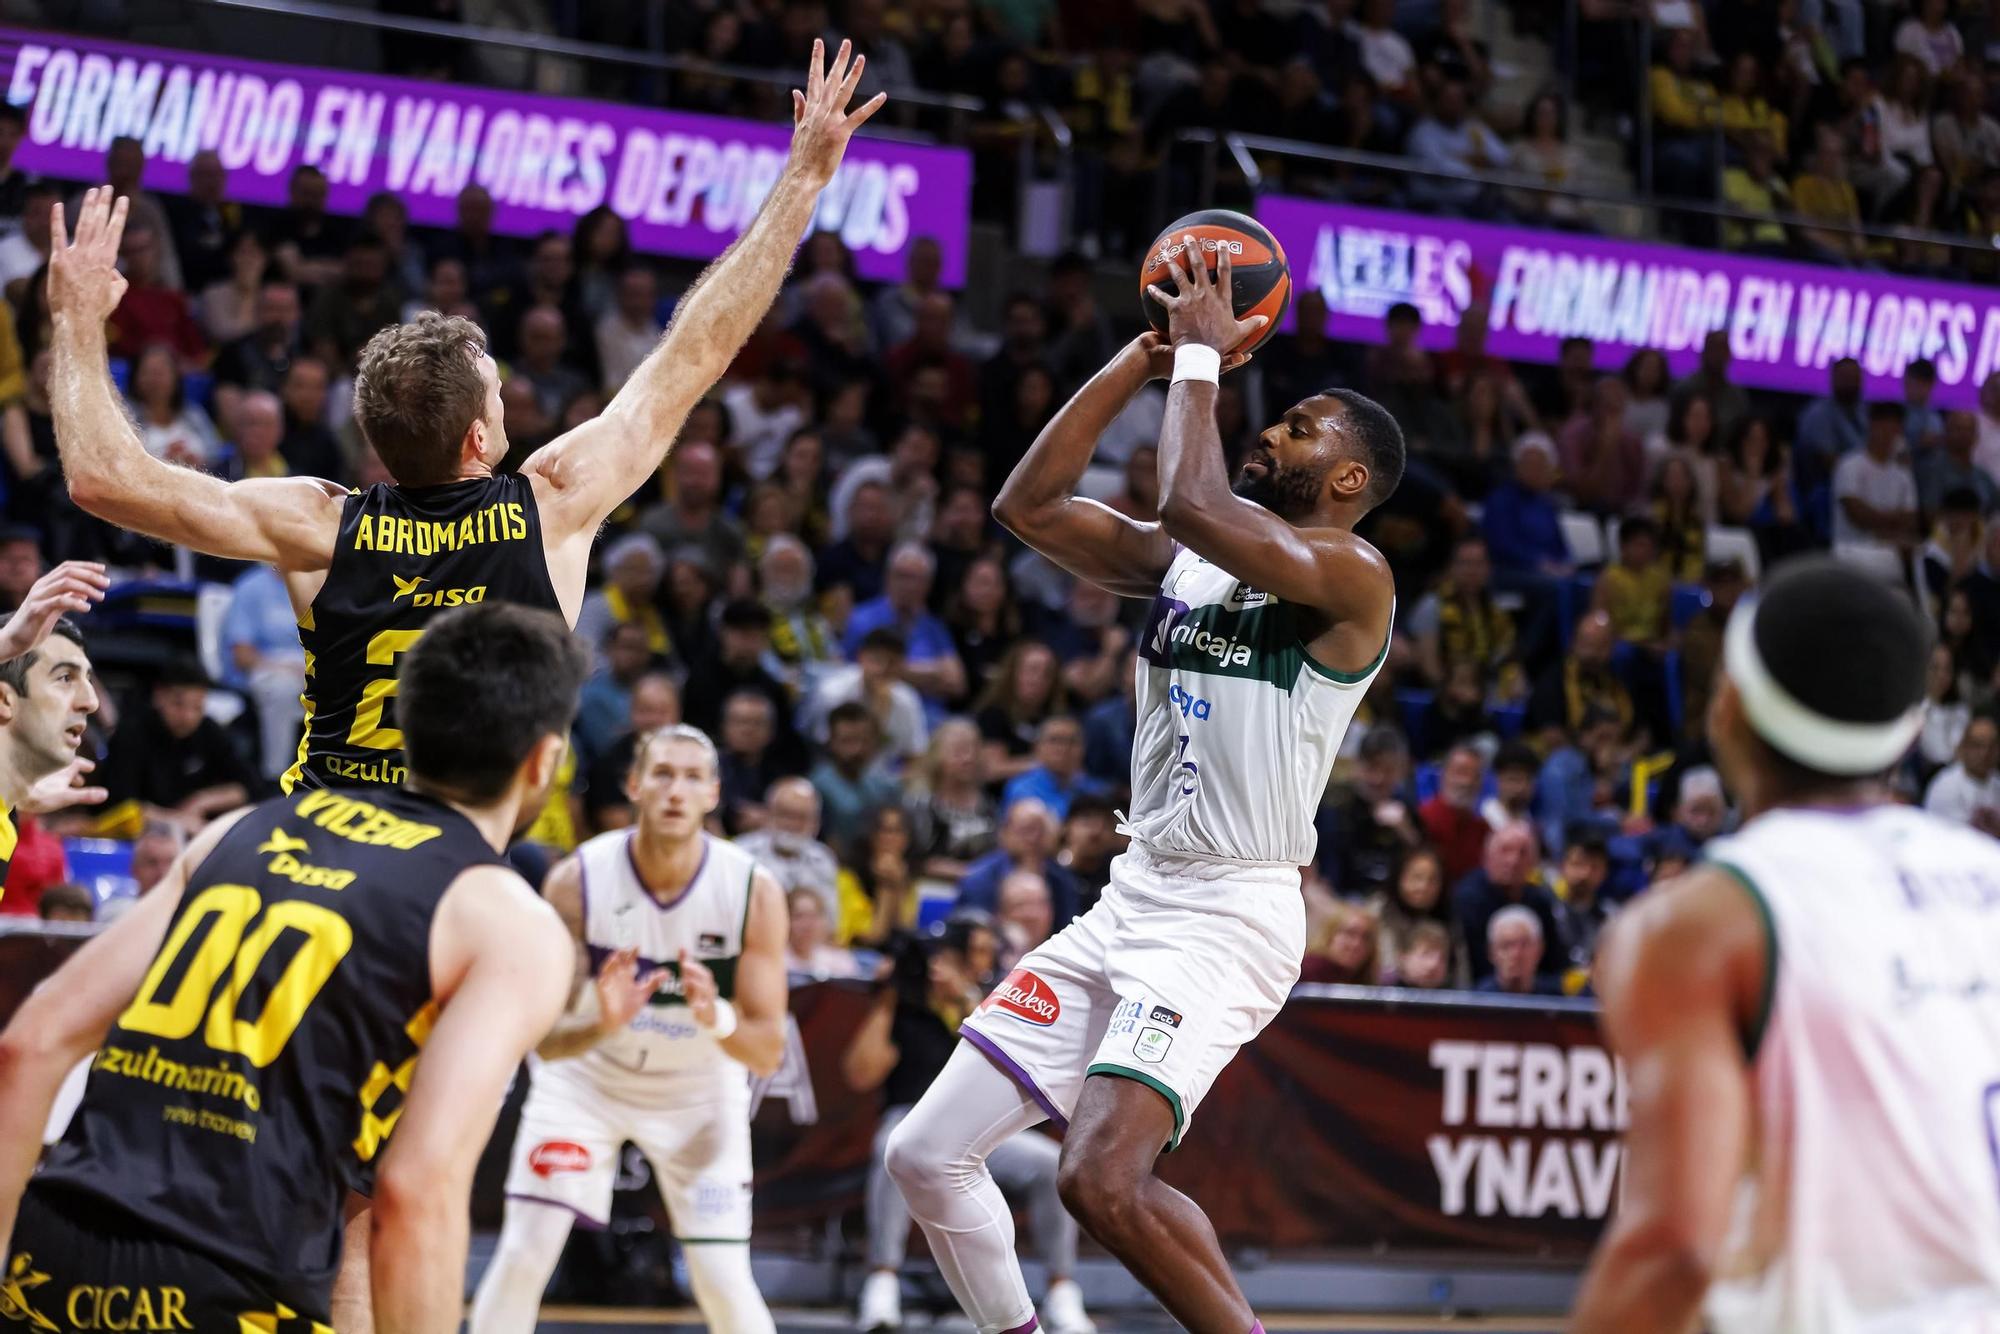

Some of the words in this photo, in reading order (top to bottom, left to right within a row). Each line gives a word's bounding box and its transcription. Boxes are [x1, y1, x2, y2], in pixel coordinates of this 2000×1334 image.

[7, 44, 304, 175] FORMANDO
[303, 84, 386, 187] EN
[386, 95, 616, 216] VALORES
[1487, 246, 1731, 353] FORMANDO
[1728, 274, 1795, 364] EN
[1794, 284, 1976, 386] VALORES
[354, 503, 527, 556] ABROMAITIS
[346, 630, 426, 750] 2
[118, 884, 353, 1068] 00
[1152, 1011, 1174, 1025] acb
[1426, 1133, 1625, 1218] YNAV
[66, 1285, 195, 1331] CICAR
